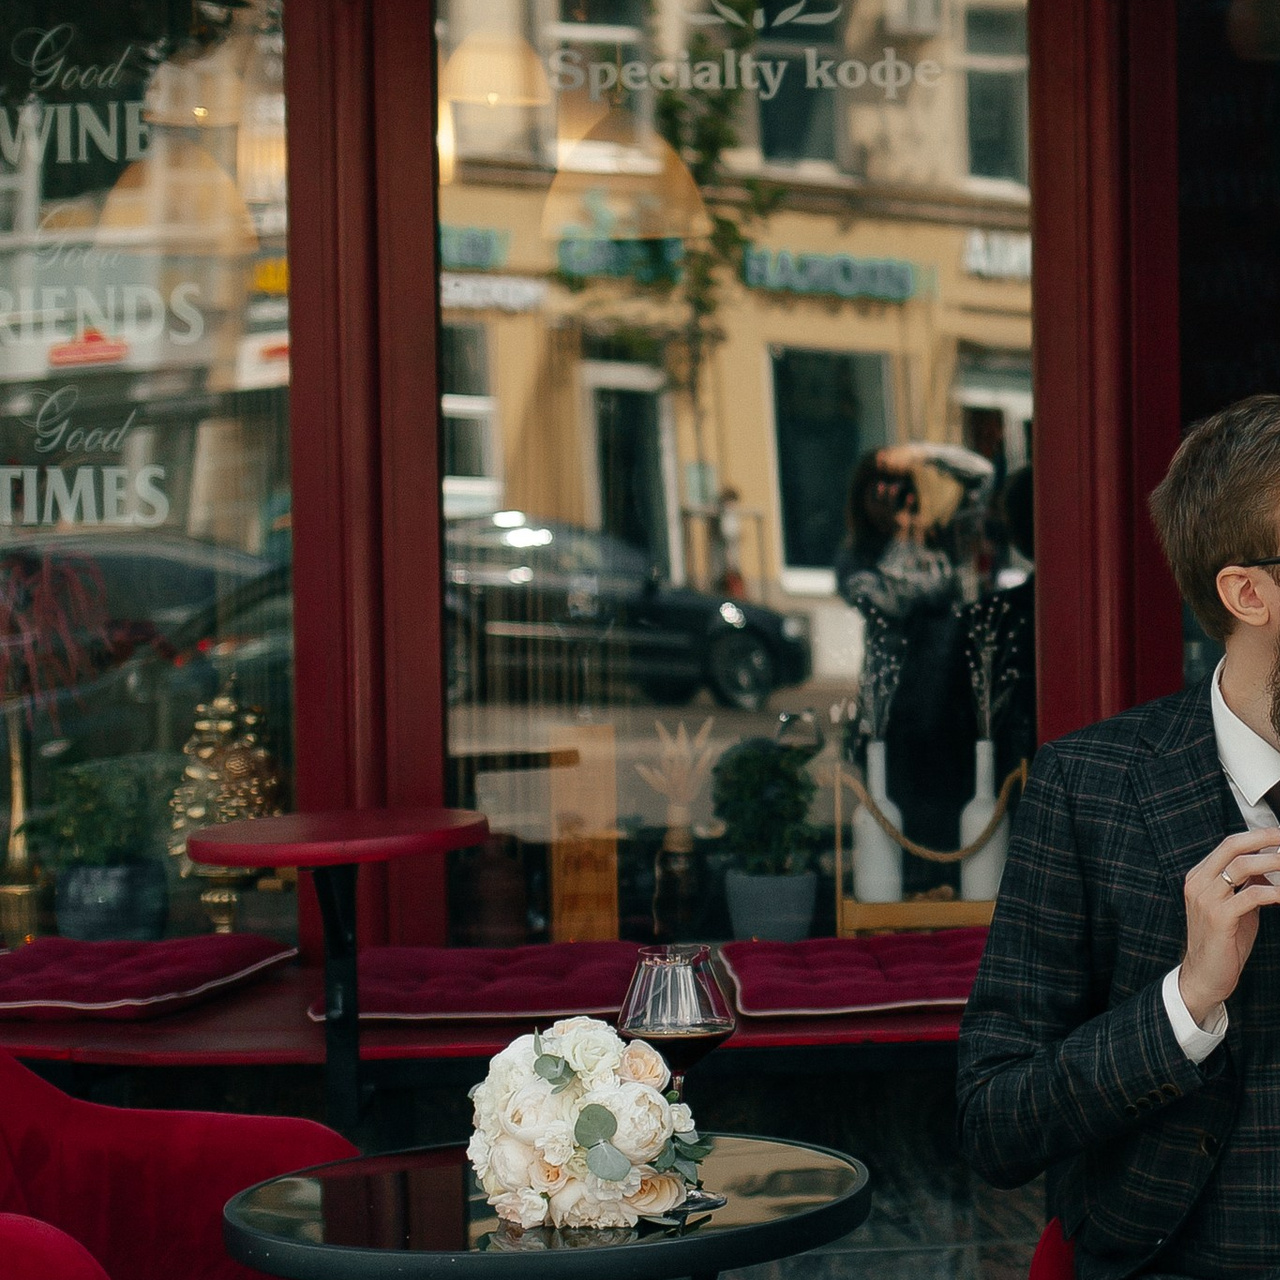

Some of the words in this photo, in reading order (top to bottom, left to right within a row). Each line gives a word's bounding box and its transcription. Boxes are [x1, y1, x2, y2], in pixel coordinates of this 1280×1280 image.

[11, 23, 132, 91] Good
[548, 48, 790, 100] Specialty
[804, 48, 944, 100] кофе
[0, 101, 152, 166] WINE
[20, 384, 137, 454] Good
[0, 465, 170, 528] TIMES
